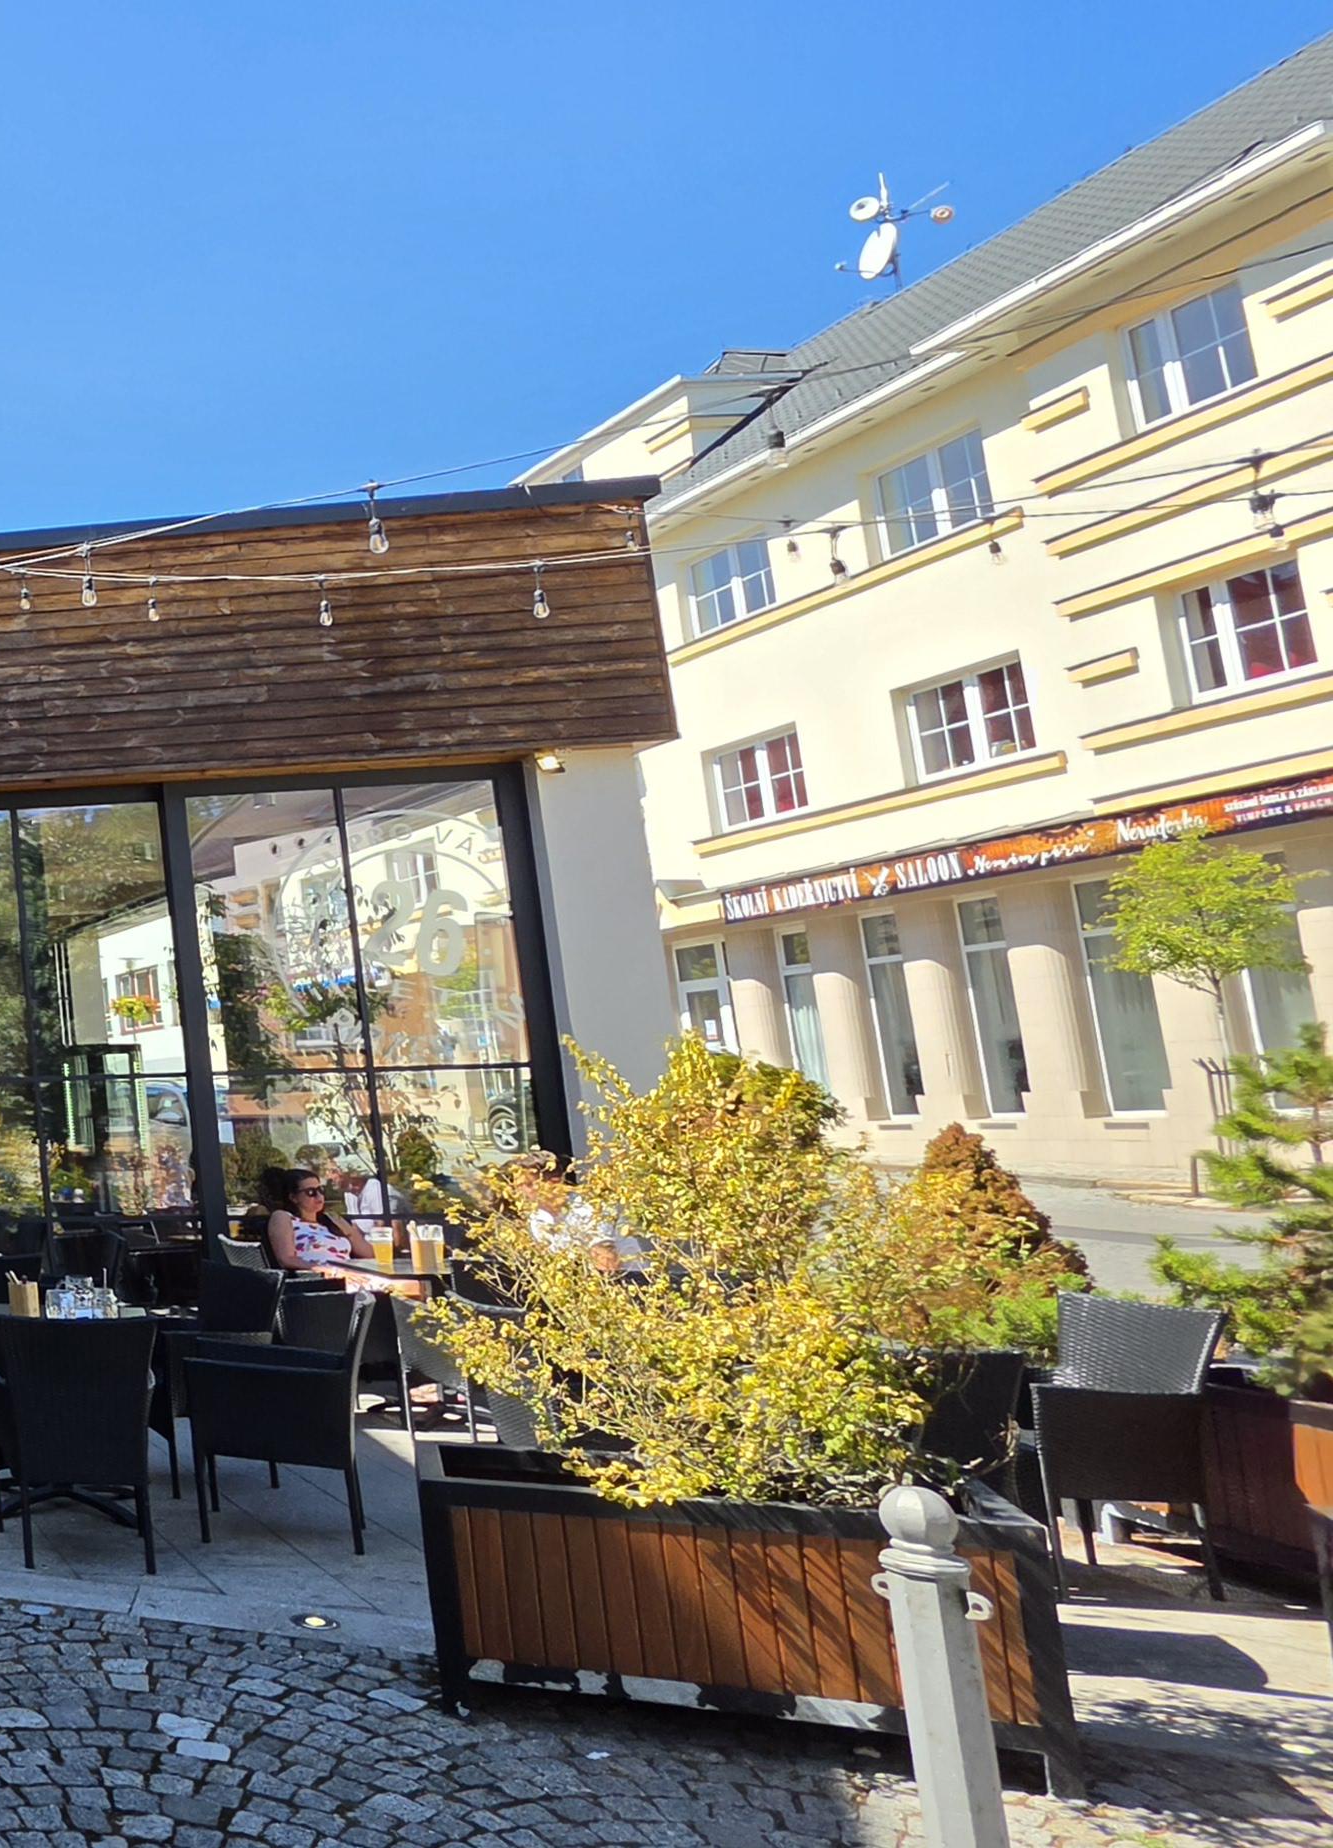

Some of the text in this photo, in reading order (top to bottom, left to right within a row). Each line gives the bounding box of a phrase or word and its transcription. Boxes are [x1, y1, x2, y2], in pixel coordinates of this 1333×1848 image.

[349, 823, 414, 848] PRO
[724, 885, 770, 920] ŠKOLNÍ
[772, 868, 861, 912] KADEŘNICTVÍ
[895, 851, 963, 889] SALOON
[362, 880, 468, 976] 26
